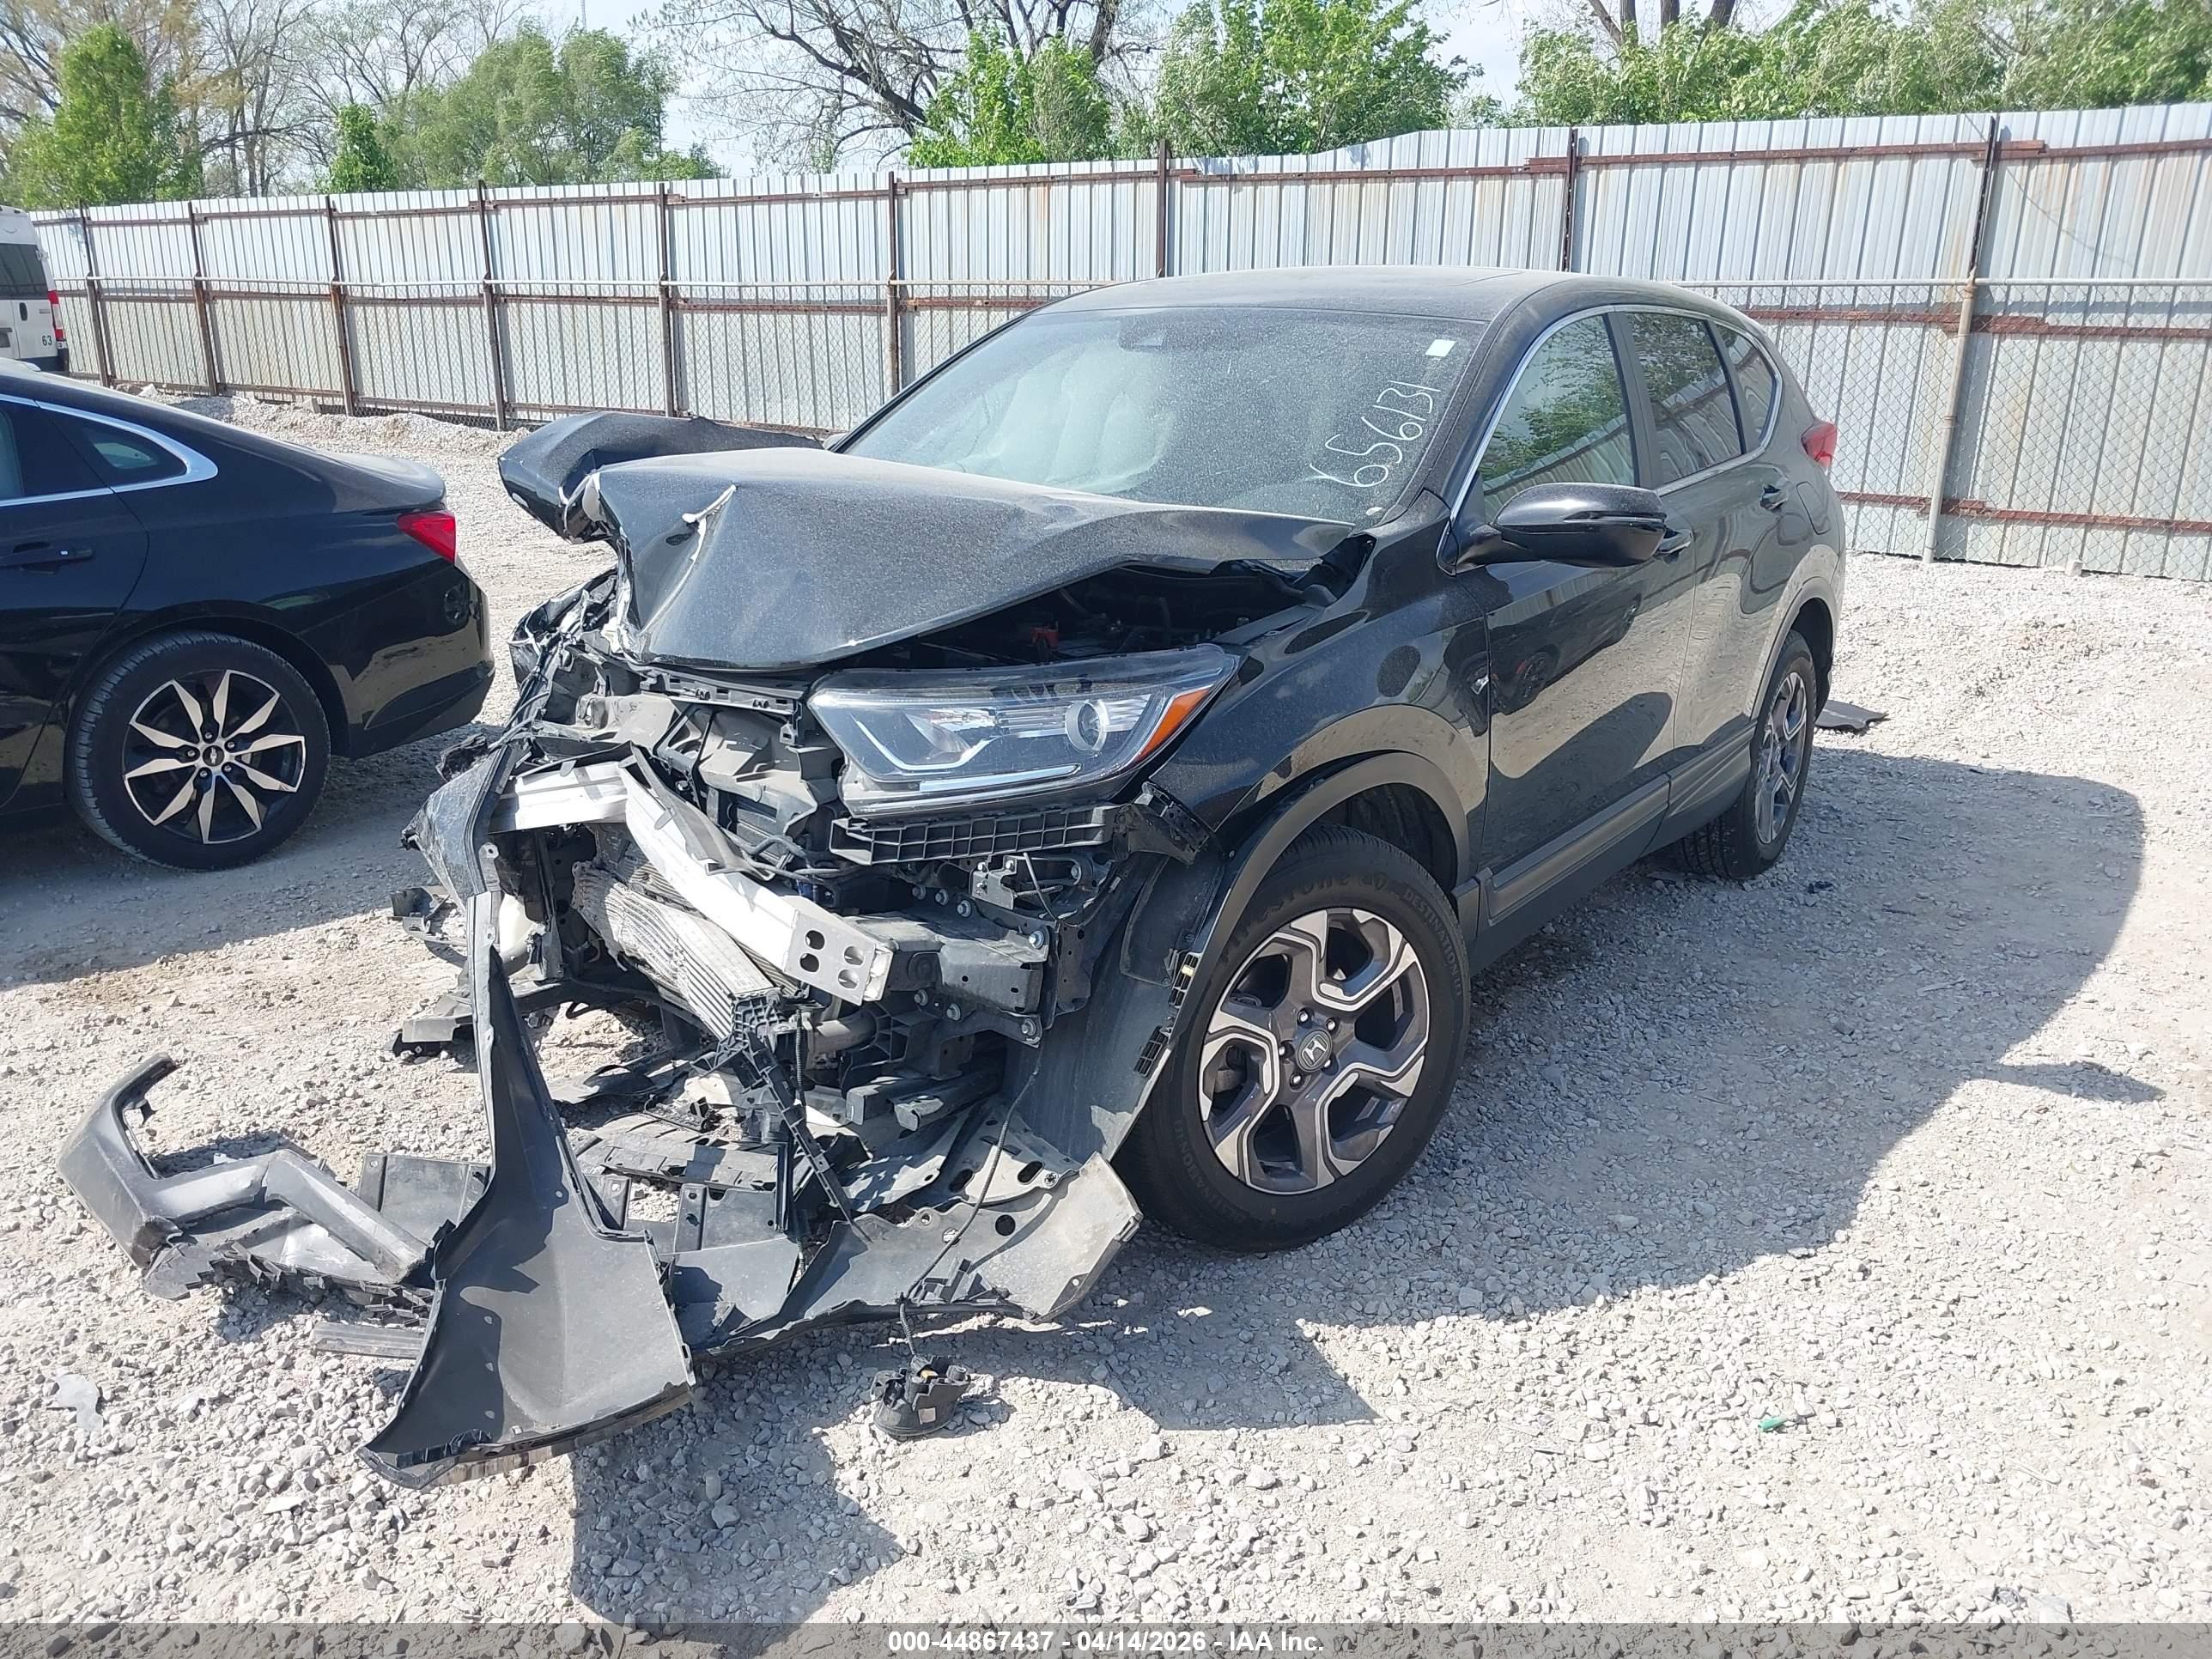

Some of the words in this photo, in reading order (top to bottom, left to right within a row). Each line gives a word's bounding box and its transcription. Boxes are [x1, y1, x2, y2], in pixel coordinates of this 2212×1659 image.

[42, 335, 53, 346] 63
[1308, 380, 1442, 488] 656131
[1401, 884, 1462, 978] DESTINATION
